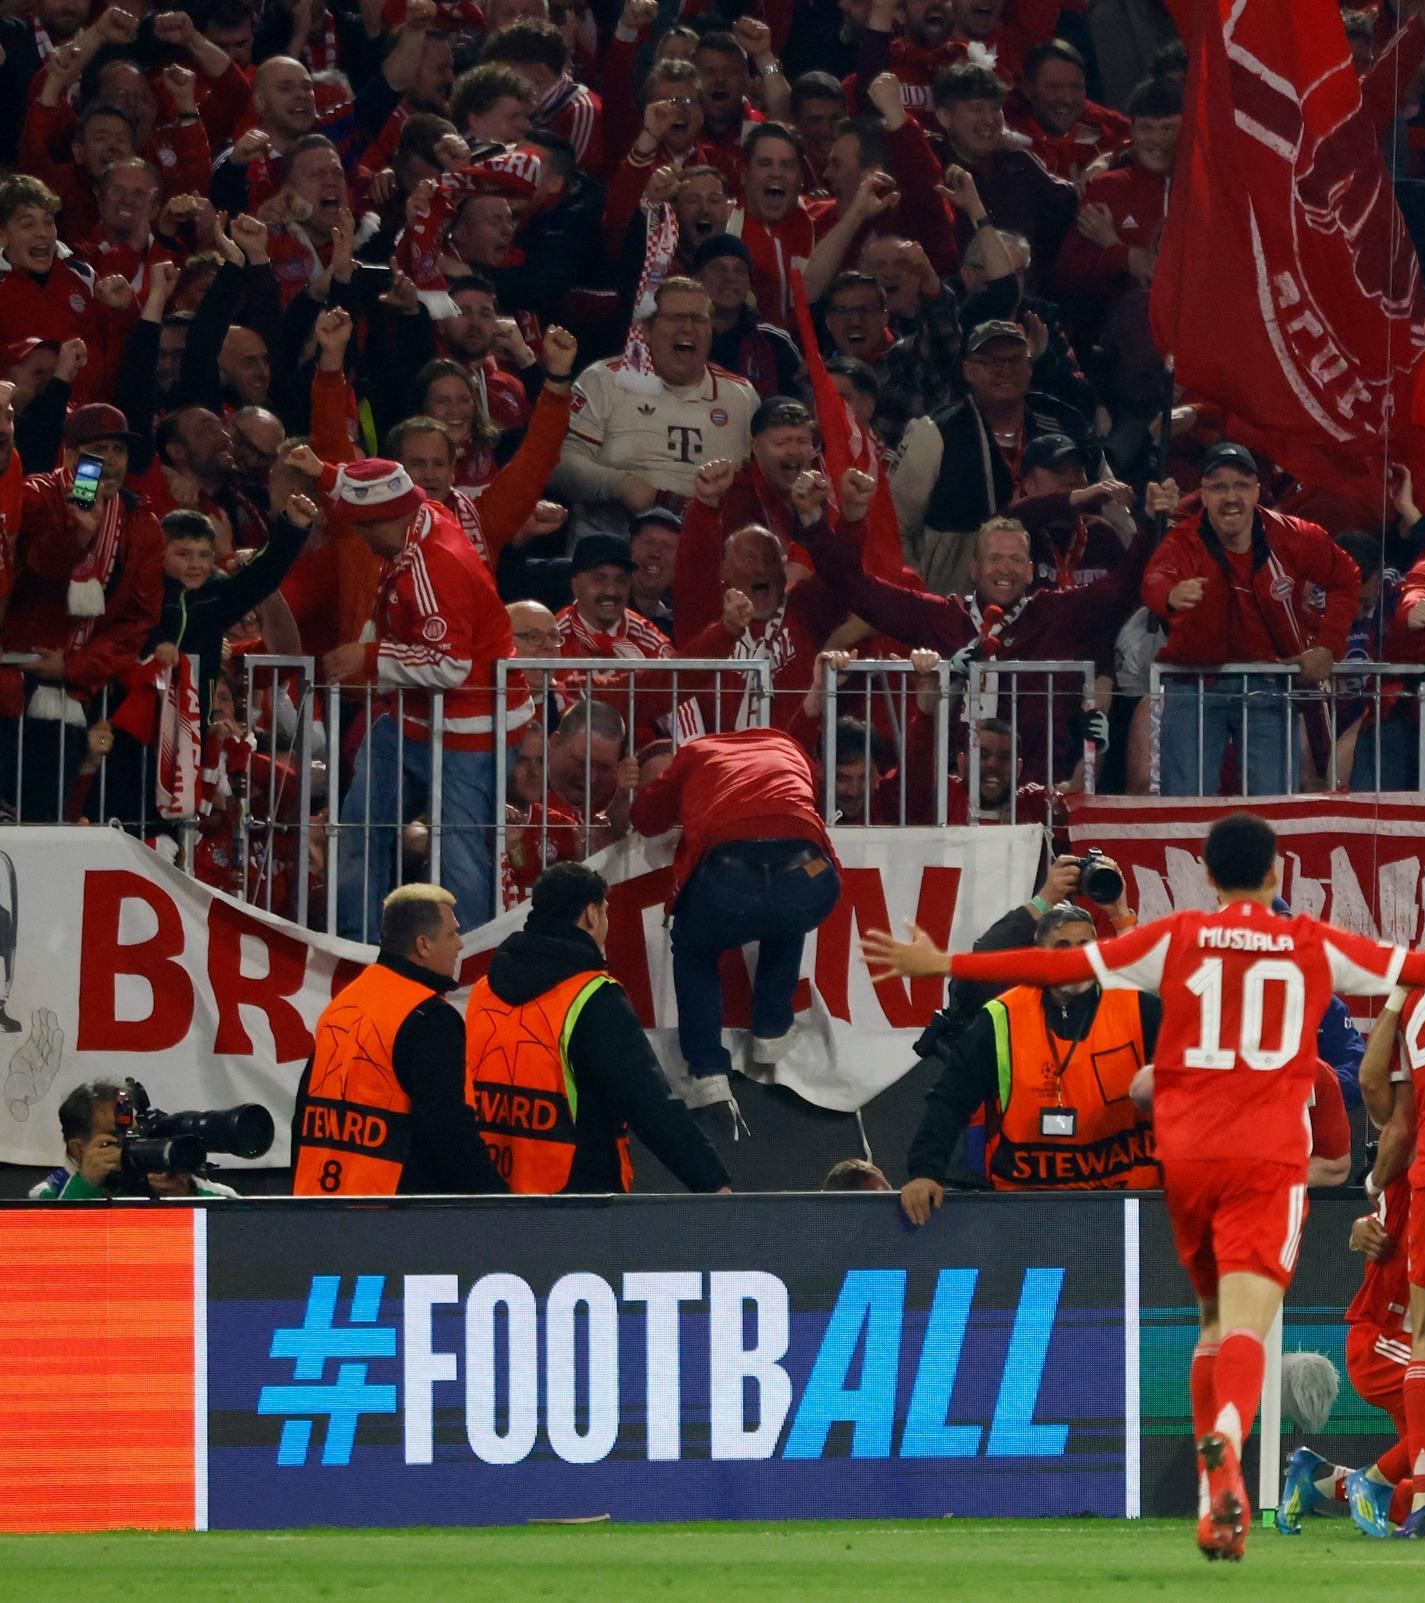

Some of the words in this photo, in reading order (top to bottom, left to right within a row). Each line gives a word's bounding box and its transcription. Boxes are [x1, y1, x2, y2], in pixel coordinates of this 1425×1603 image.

[1198, 926, 1295, 953] MUSIALA
[1184, 957, 1305, 1071] 10
[318, 1159, 344, 1193] 8
[257, 1267, 1069, 1467] #FOOTBALL
